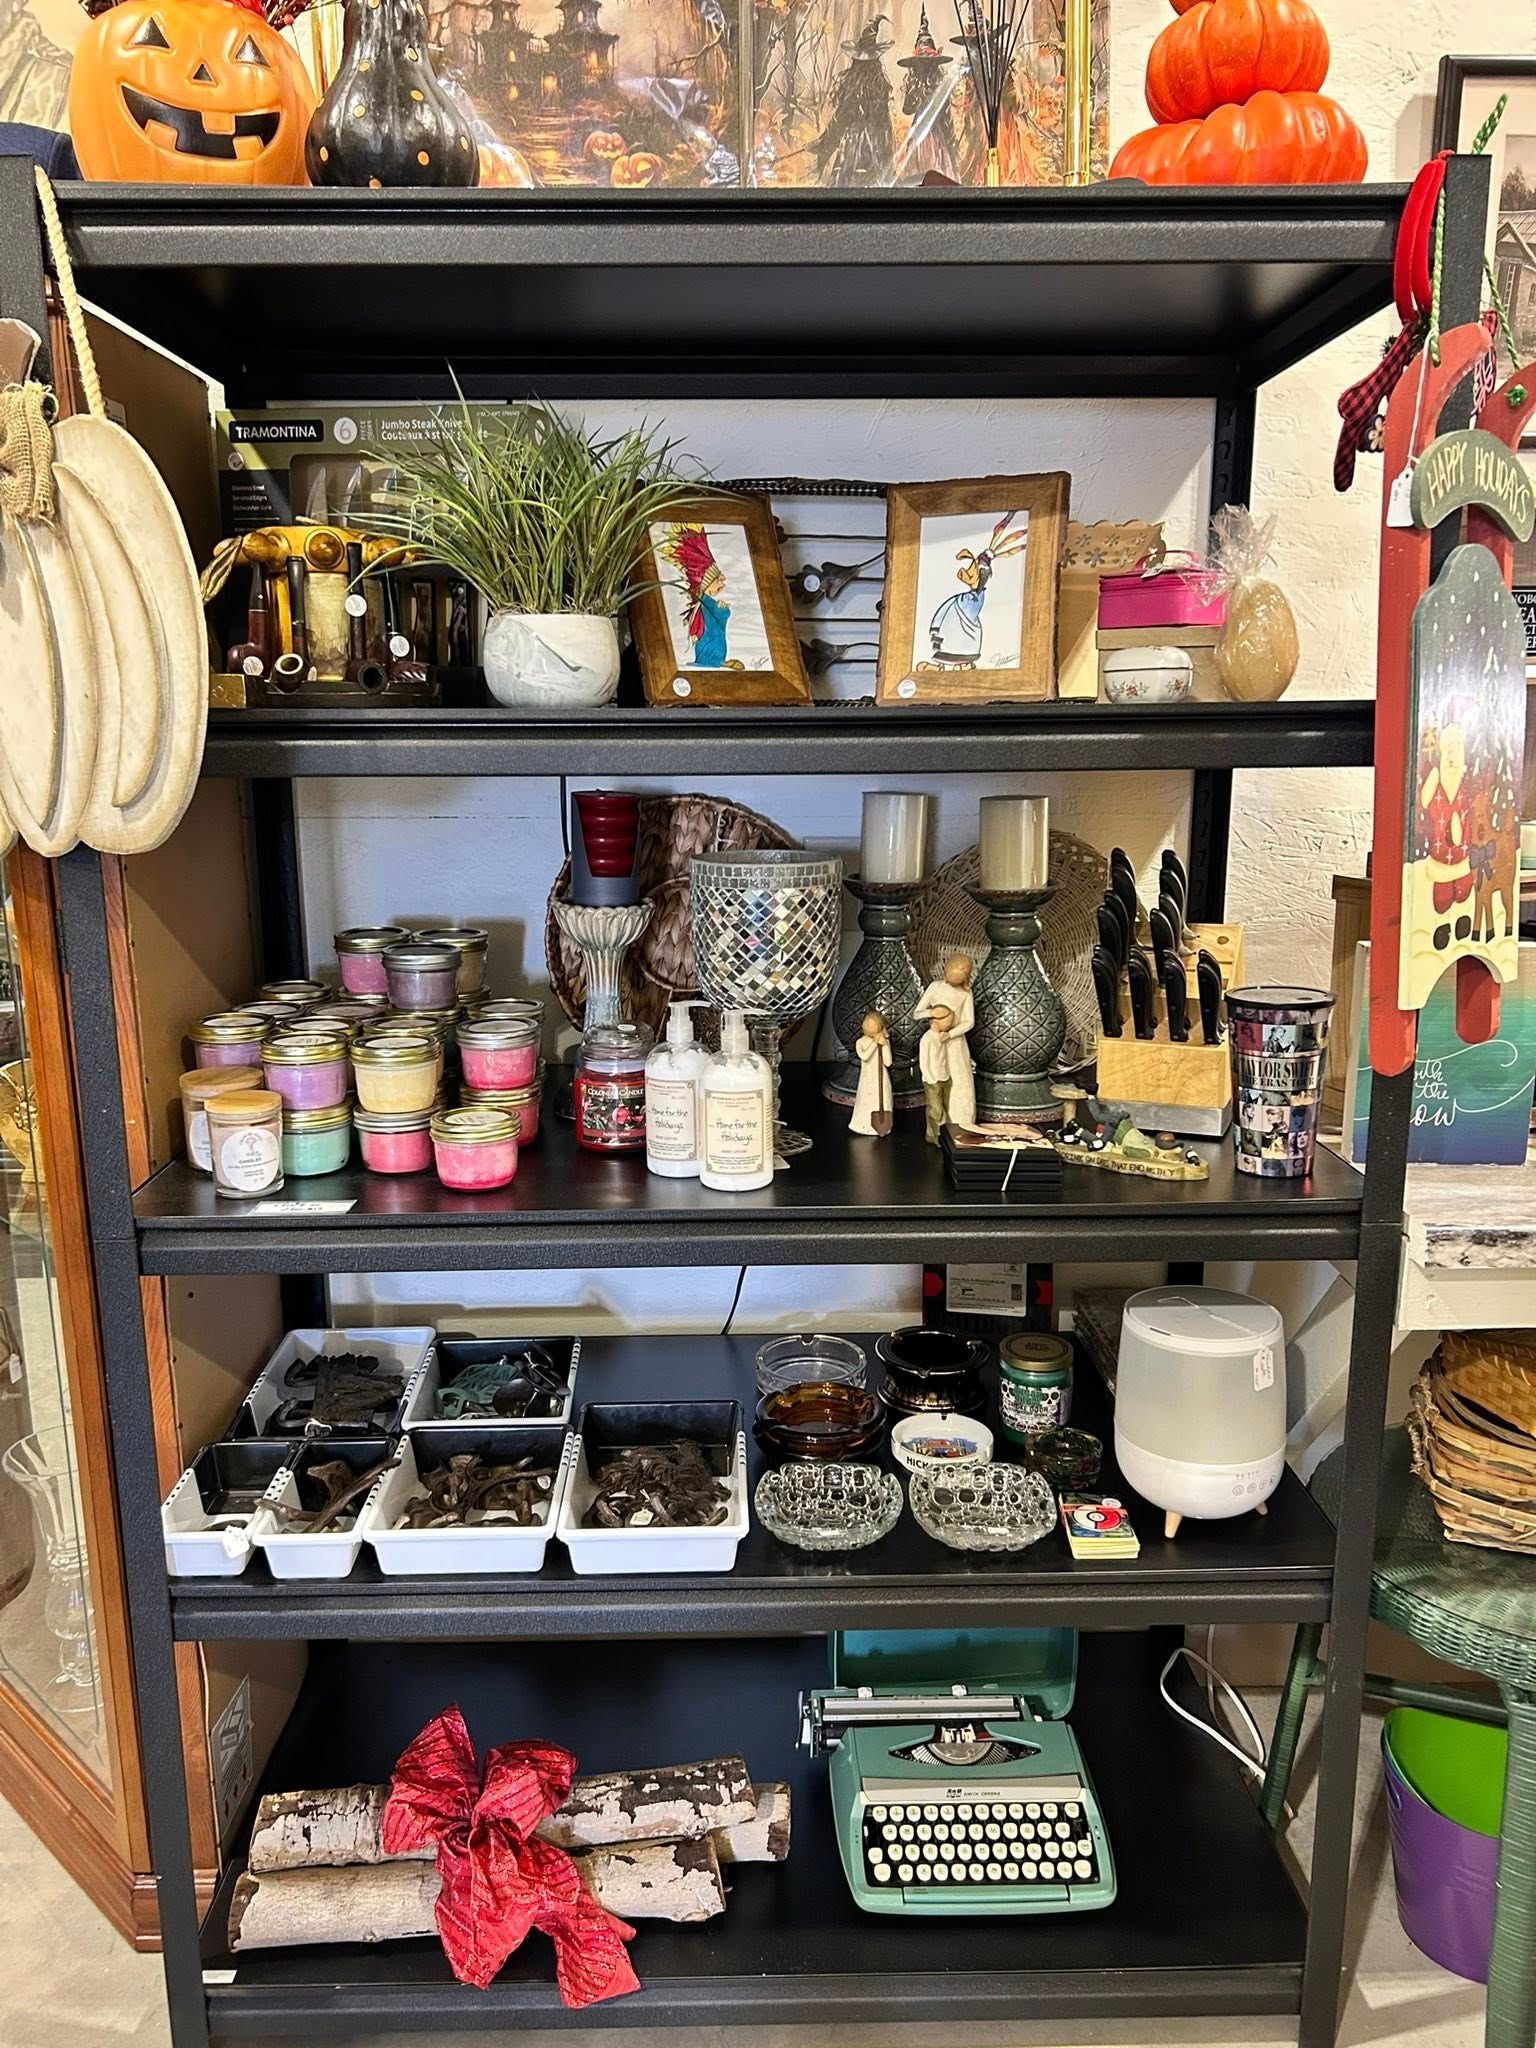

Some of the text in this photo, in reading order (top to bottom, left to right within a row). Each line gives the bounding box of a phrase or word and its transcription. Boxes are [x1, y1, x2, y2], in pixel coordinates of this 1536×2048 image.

[339, 420, 351, 441] 6
[381, 420, 410, 430] Jumbo
[412, 419, 437, 429] Steak
[235, 426, 317, 439] TRAMONTINA
[1427, 441, 1530, 523] HAPPY HOLIDAYS
[1240, 1057, 1317, 1079] TAYLOR SWIFT
[1260, 1078, 1288, 1087] ERAS
[1415, 1082, 1450, 1099] the
[676, 1107, 688, 1117] the
[655, 1117, 684, 1134] Holidays
[716, 1118, 758, 1129] Home for the
[721, 1130, 753, 1146] Holidays
[1111, 1160, 1128, 1170] THAT
[1129, 1163, 1144, 1172] END
